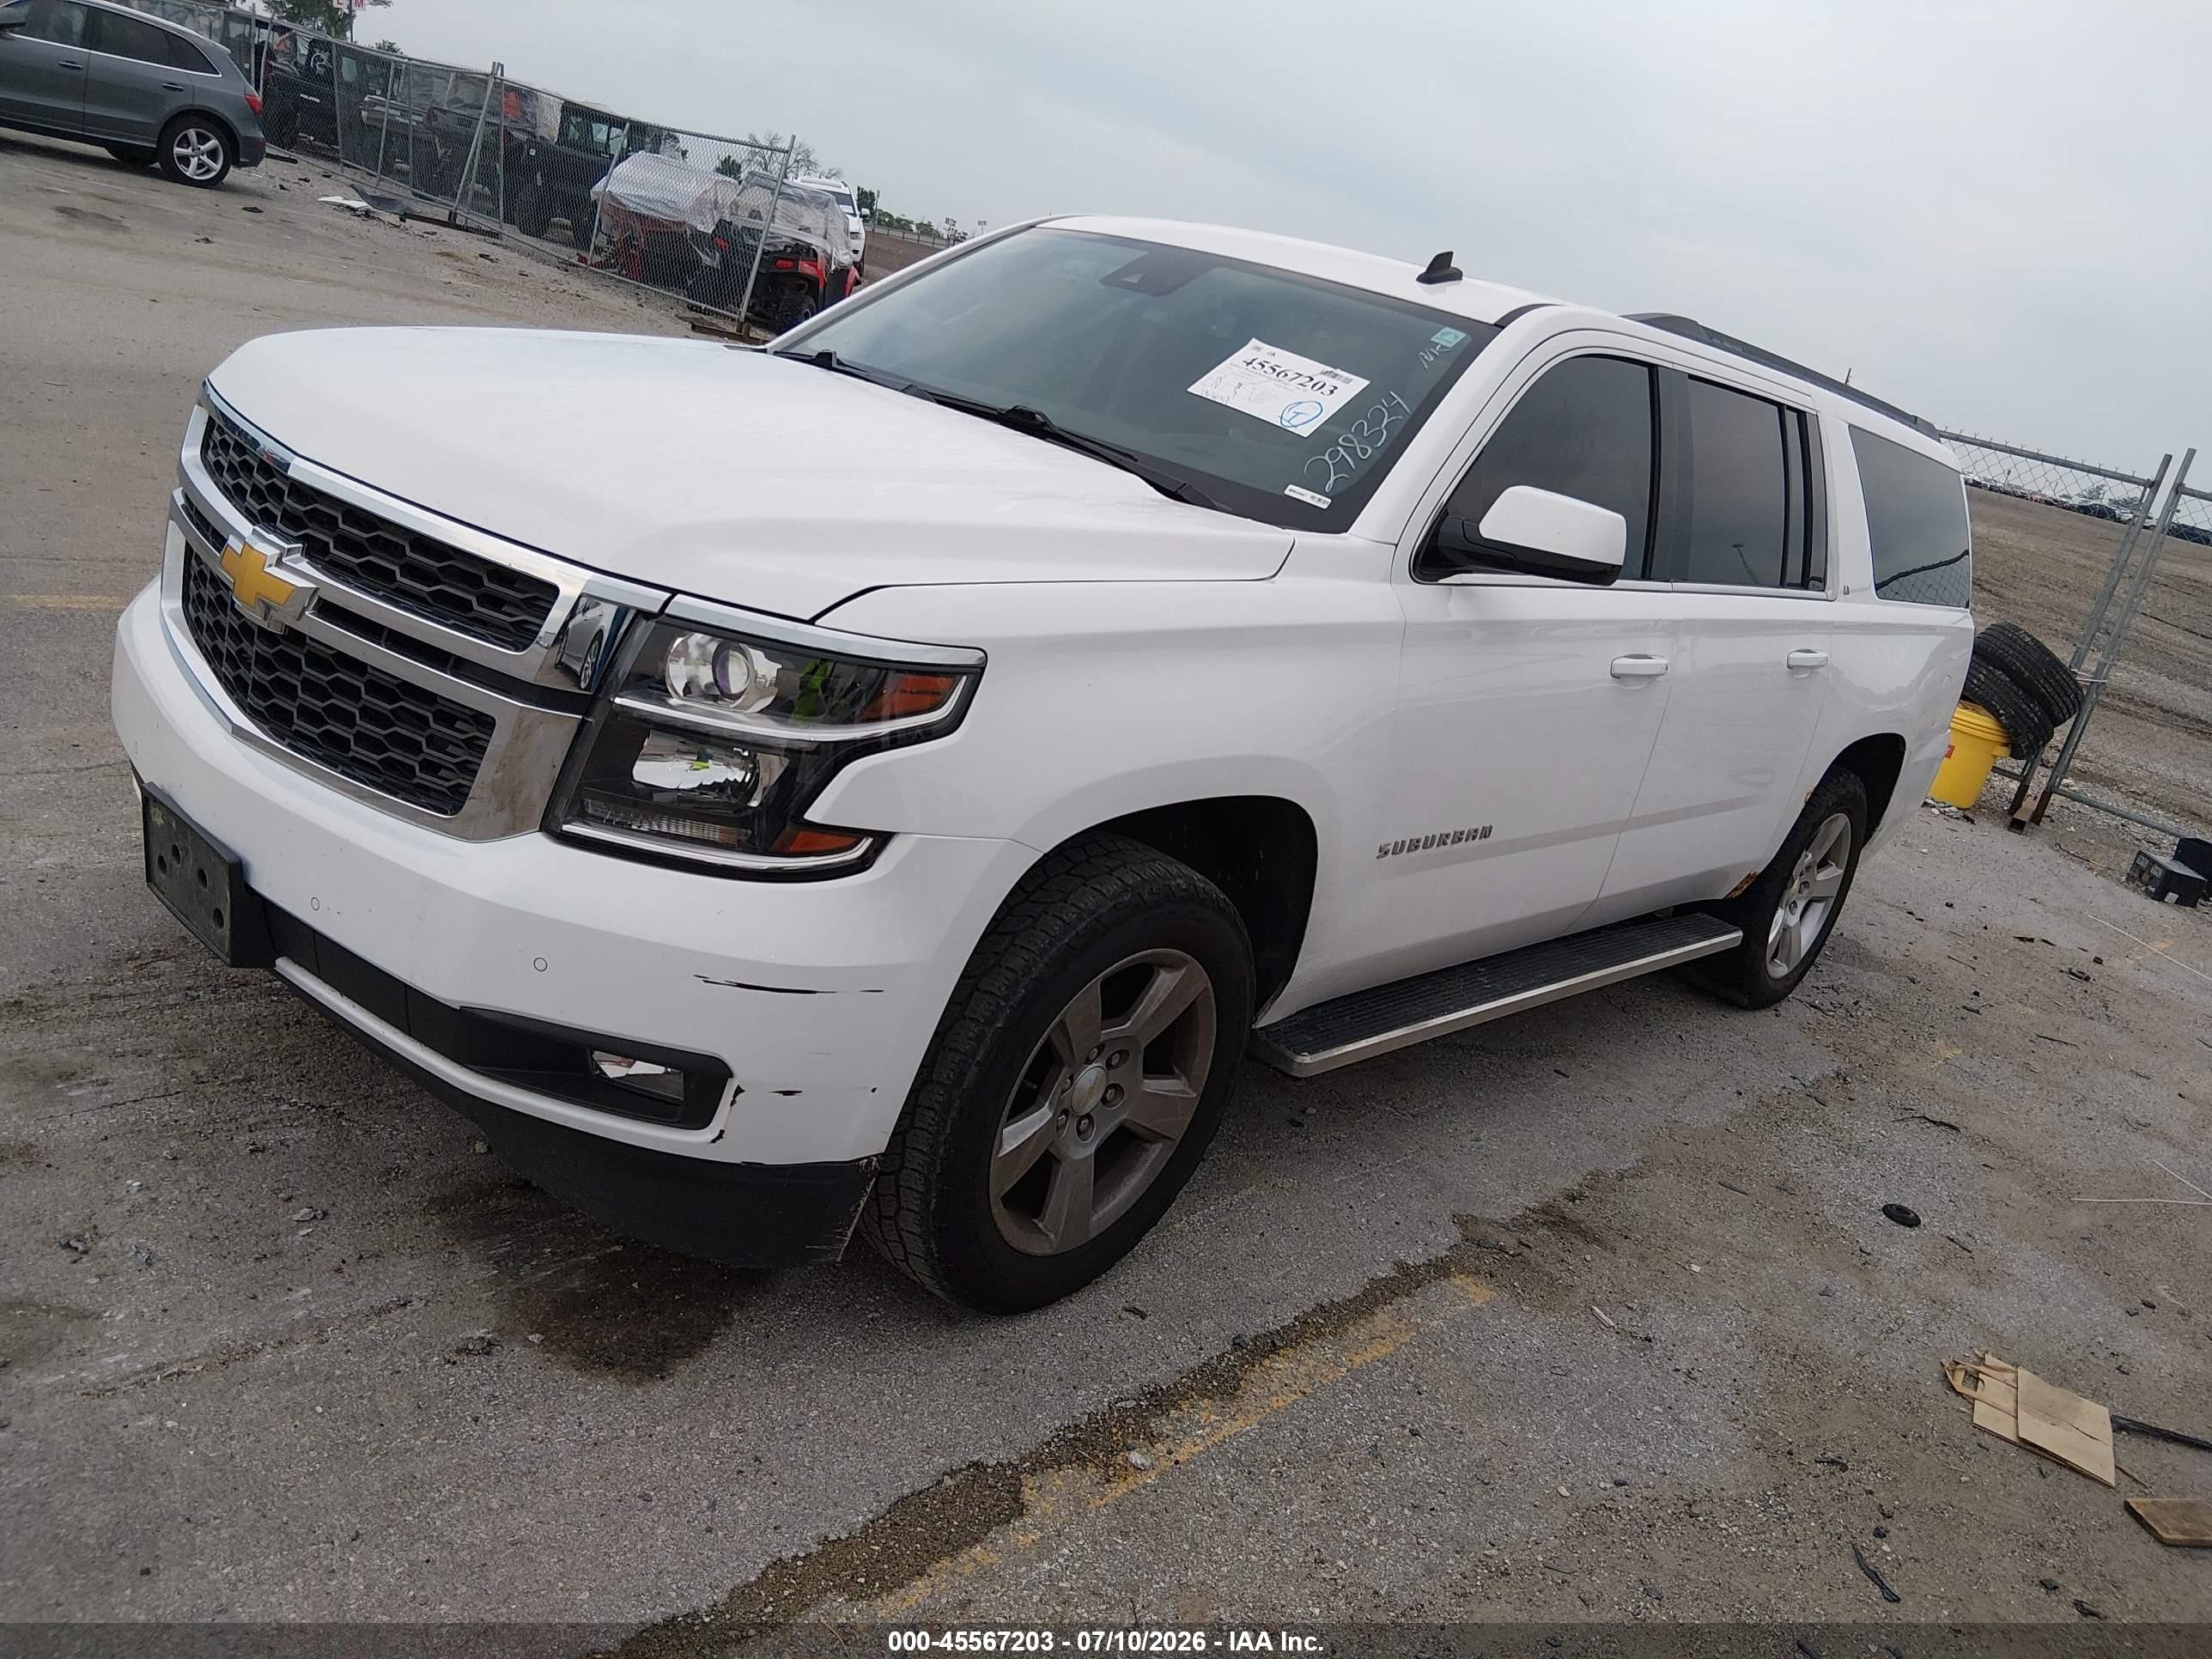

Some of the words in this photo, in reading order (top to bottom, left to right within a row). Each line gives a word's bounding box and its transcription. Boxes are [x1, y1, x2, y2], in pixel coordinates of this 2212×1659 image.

[1243, 356, 1339, 397] 45567203
[1304, 391, 1411, 493] 298324
[1376, 824, 1493, 860] SUBURBAN
